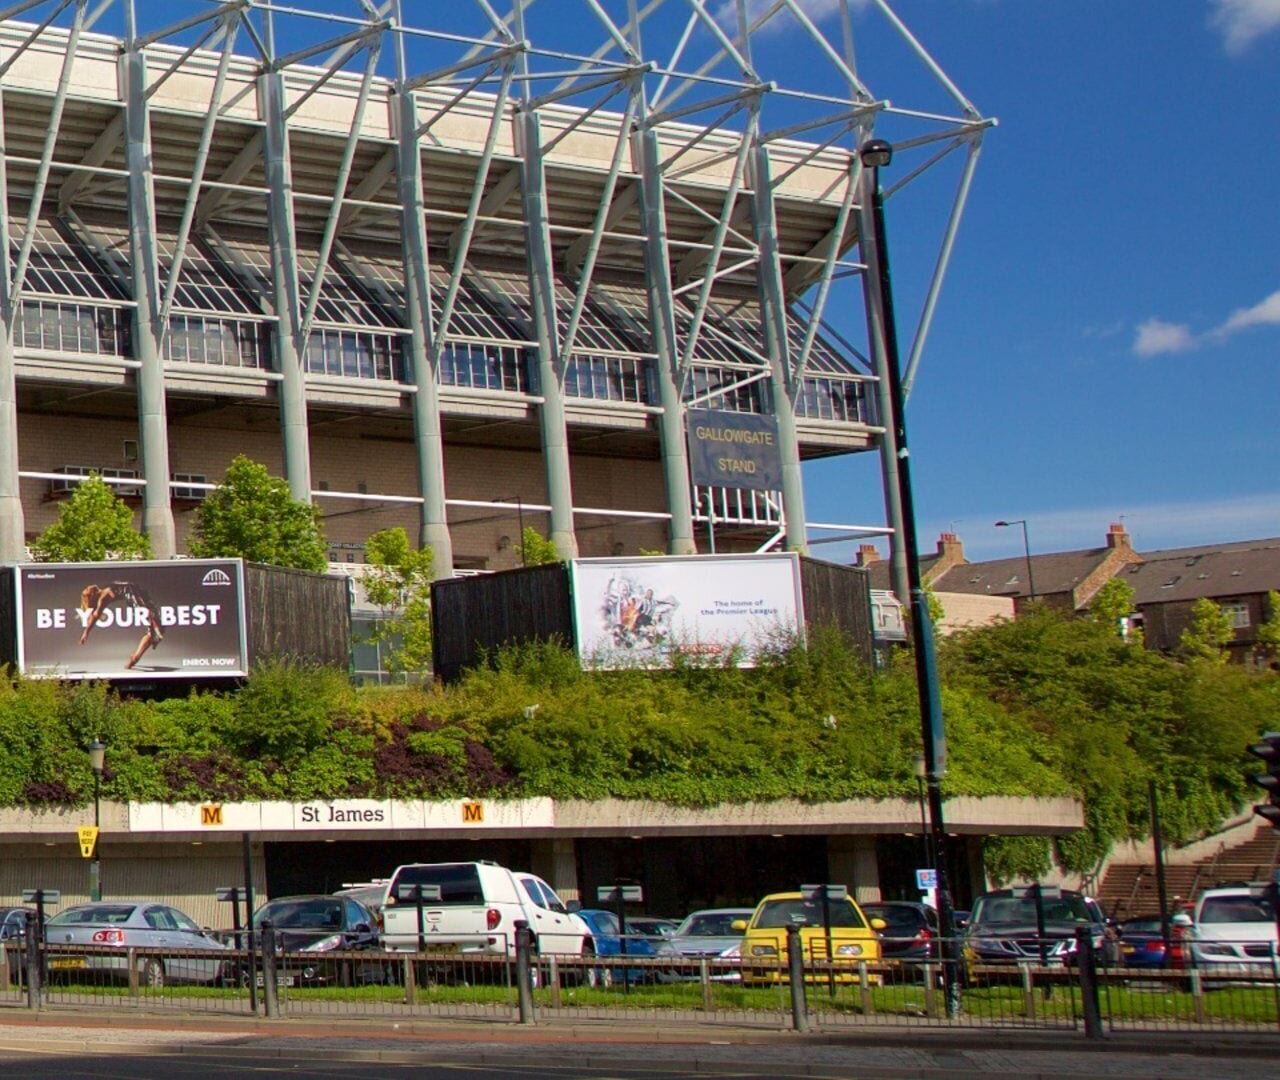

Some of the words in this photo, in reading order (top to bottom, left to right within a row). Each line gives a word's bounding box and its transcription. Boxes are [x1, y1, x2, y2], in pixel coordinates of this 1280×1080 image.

[696, 426, 773, 445] GALLOWGATE
[718, 458, 756, 473] STAND
[37, 609, 66, 628] BE
[76, 607, 152, 628] YOUR
[160, 605, 220, 626] BEST
[749, 608, 778, 616] League
[182, 658, 210, 666] ENROL
[211, 658, 235, 666] NOW
[203, 807, 221, 823] M
[301, 806, 319, 822] St
[328, 806, 384, 822] James
[464, 805, 482, 821] M
